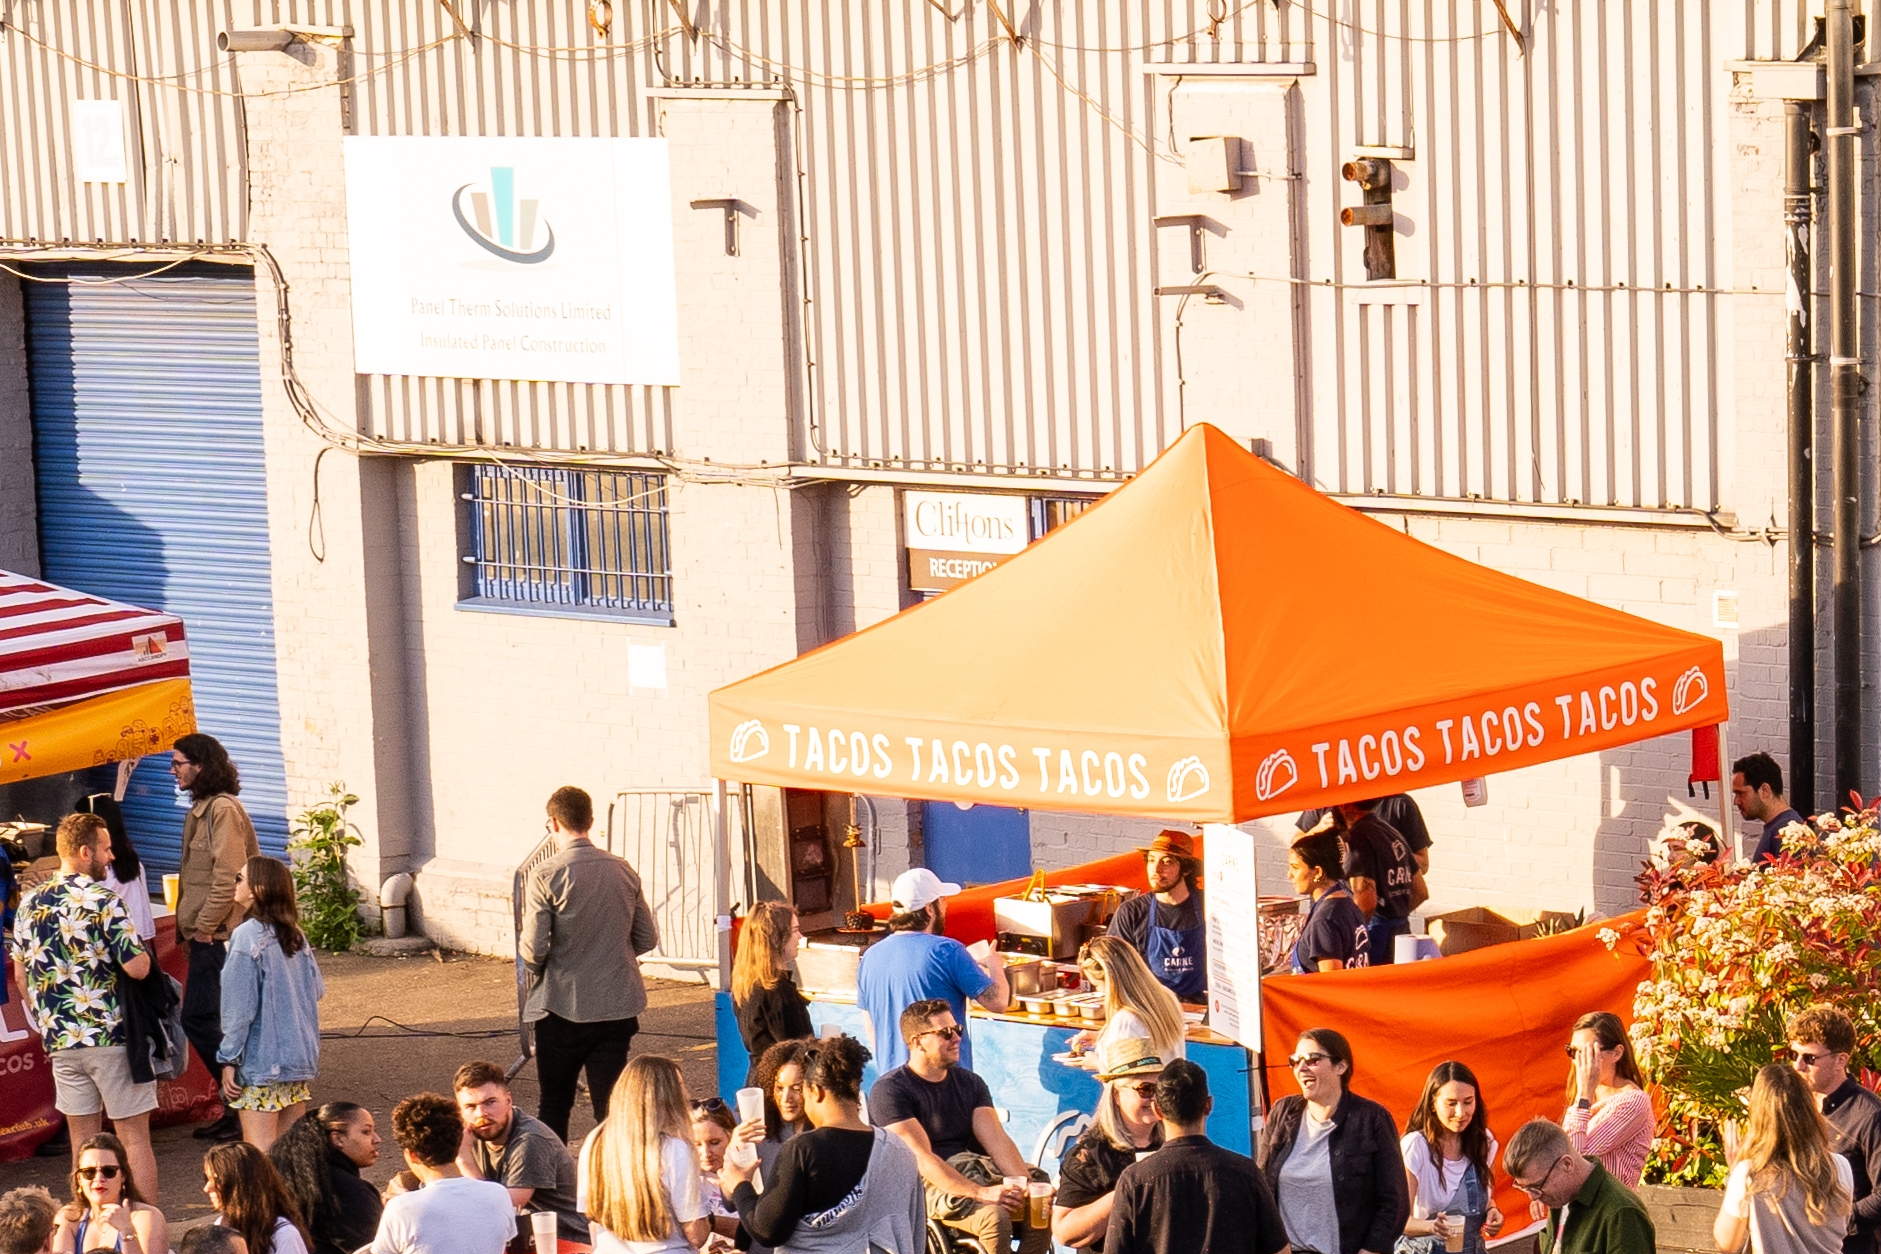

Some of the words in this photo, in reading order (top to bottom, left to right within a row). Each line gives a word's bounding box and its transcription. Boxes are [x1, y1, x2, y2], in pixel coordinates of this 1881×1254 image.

[412, 297, 444, 316] Panel
[450, 298, 490, 317] Therm
[496, 299, 556, 319] Solutions
[561, 301, 611, 320] Limited
[421, 332, 477, 350] Insulated
[483, 334, 516, 351] Panel
[520, 335, 606, 354] Construction
[916, 499, 1013, 544] Cliftons
[1312, 726, 1425, 789] TACOS
[1436, 701, 1545, 764] TACOS
[1555, 677, 1658, 736] TACOS
[784, 724, 892, 779] TACOS
[906, 737, 1020, 789] TACOS
[1033, 747, 1150, 800] TACOS
[1388, 866, 1412, 886] CARN
[1164, 956, 1193, 967] CARNE
